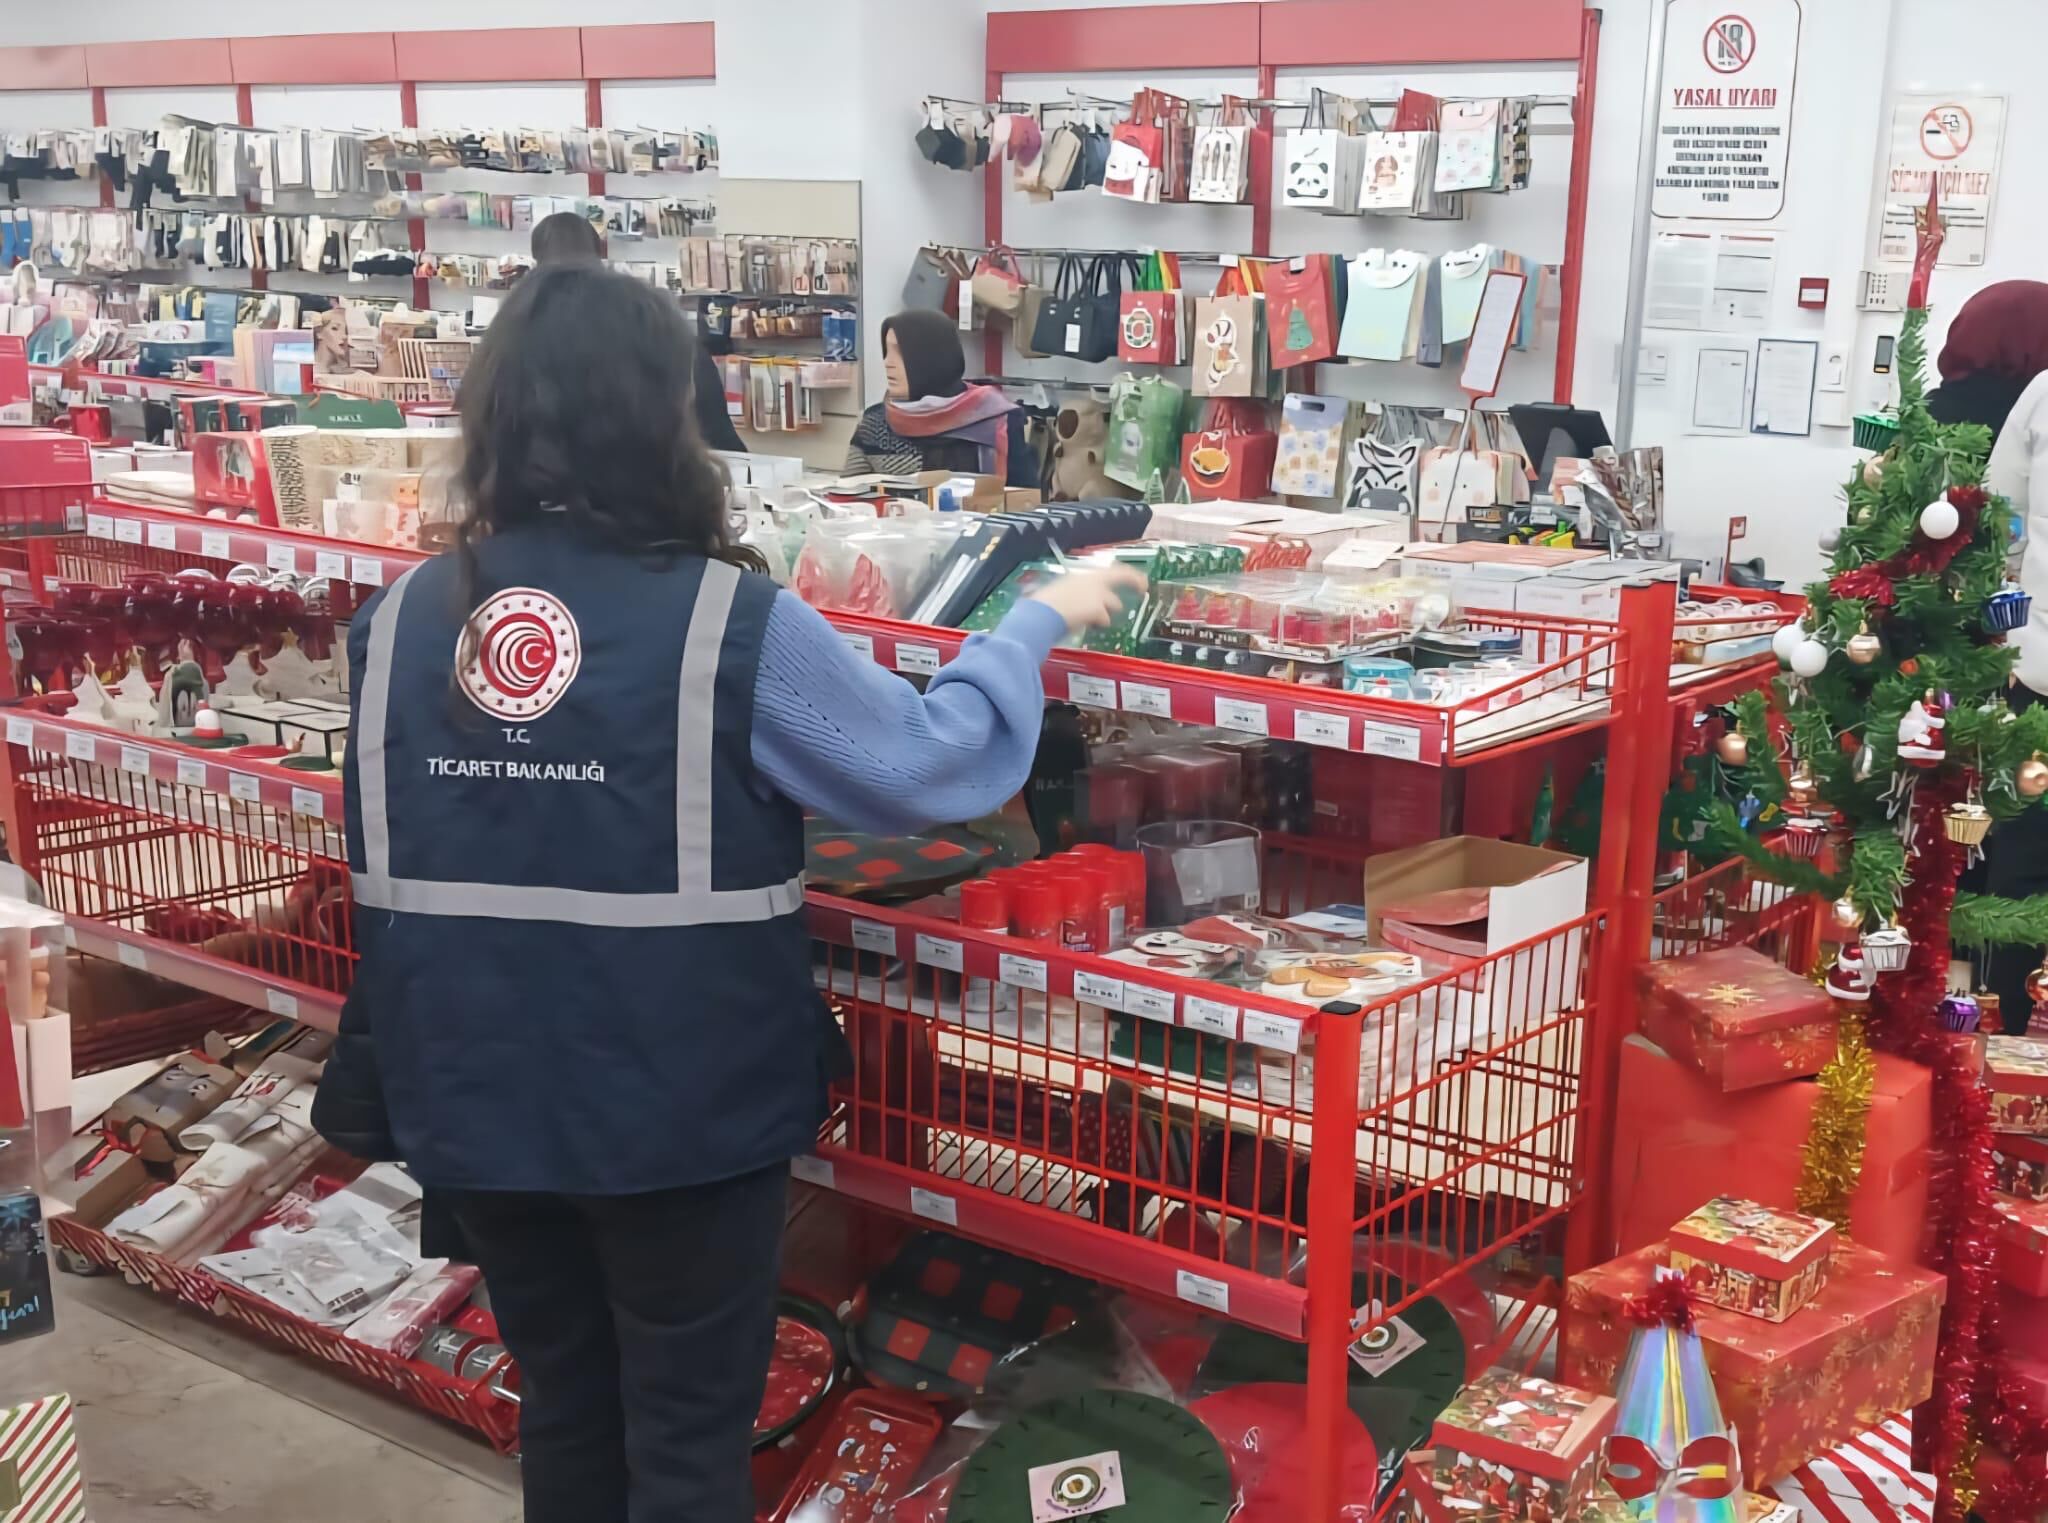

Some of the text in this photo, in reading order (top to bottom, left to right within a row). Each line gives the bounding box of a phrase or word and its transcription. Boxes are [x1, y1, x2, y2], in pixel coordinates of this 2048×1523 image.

[1674, 88, 1777, 107] YASAL UYARI
[427, 756, 605, 783] TİCARET BAKANLIĞI
